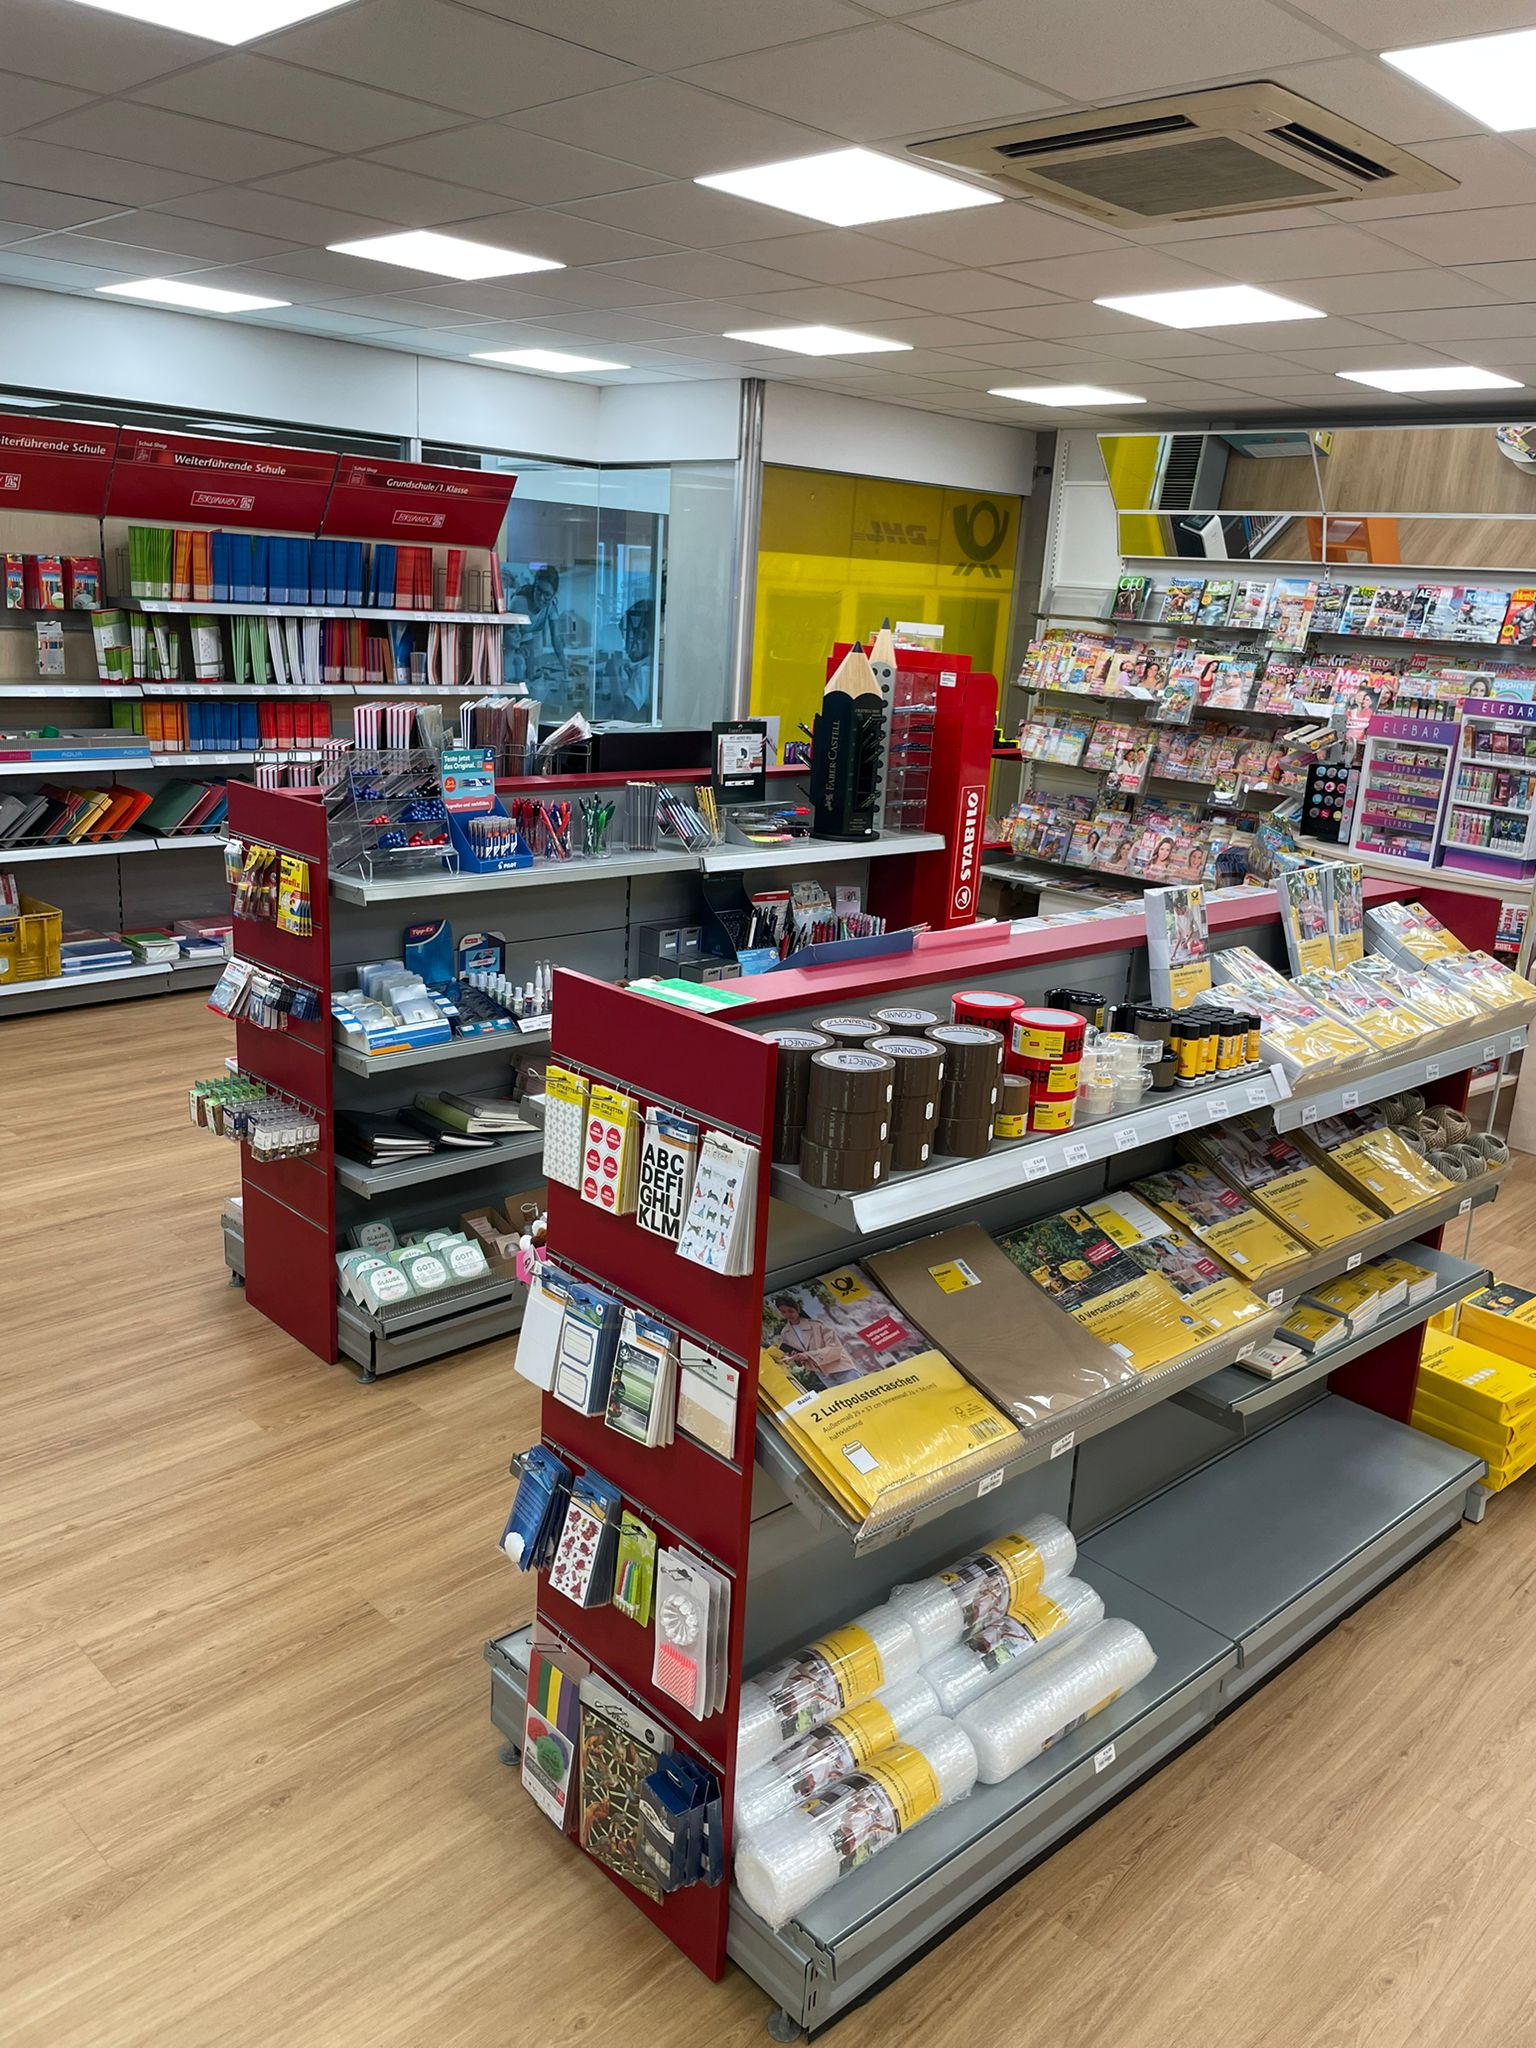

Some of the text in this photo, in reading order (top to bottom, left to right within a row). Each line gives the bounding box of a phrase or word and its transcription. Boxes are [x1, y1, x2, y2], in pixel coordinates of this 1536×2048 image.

[0, 436, 107, 455] iterführende Schule
[174, 453, 287, 475] Weiterführende Schule
[1119, 577, 1145, 591] GEO
[1481, 702, 1534, 719] ELFBAR
[1382, 721, 1440, 739] ELFBAR
[960, 791, 979, 882] STABILO
[1378, 846, 1407, 857] ELFBAR
[643, 1143, 685, 1176] ABC
[638, 1204, 680, 1240] KLM
[454, 1251, 474, 1261] GOTT
[416, 1262, 436, 1272] GOTT
[810, 1374, 920, 1423] 2 Luftpolstertaschen
